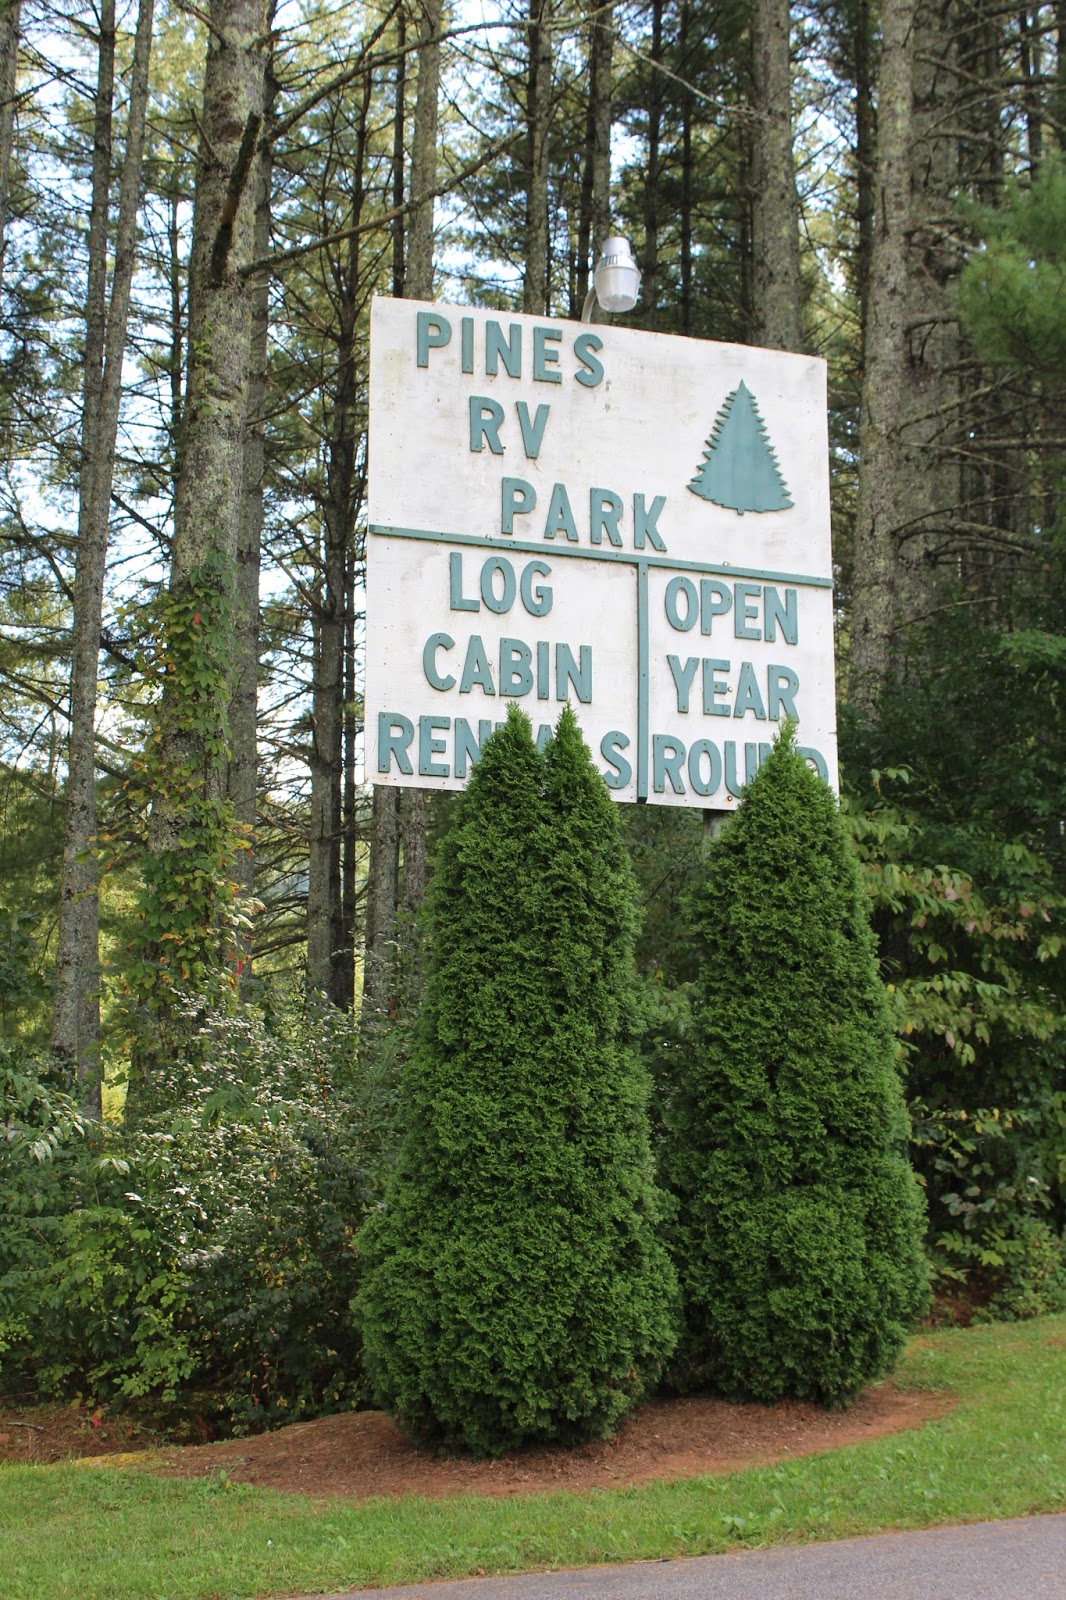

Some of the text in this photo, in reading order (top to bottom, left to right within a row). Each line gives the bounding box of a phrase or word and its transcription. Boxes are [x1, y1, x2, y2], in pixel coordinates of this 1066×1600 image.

[416, 311, 605, 388] PINES
[469, 395, 551, 459] RV
[501, 476, 668, 552] PARK
[449, 551, 554, 618] LOG
[664, 575, 799, 646] OPEN
[422, 631, 593, 704] CABIN
[666, 654, 800, 723] YEAR
[377, 711, 633, 790] RENS
[652, 733, 830, 799] ROU
